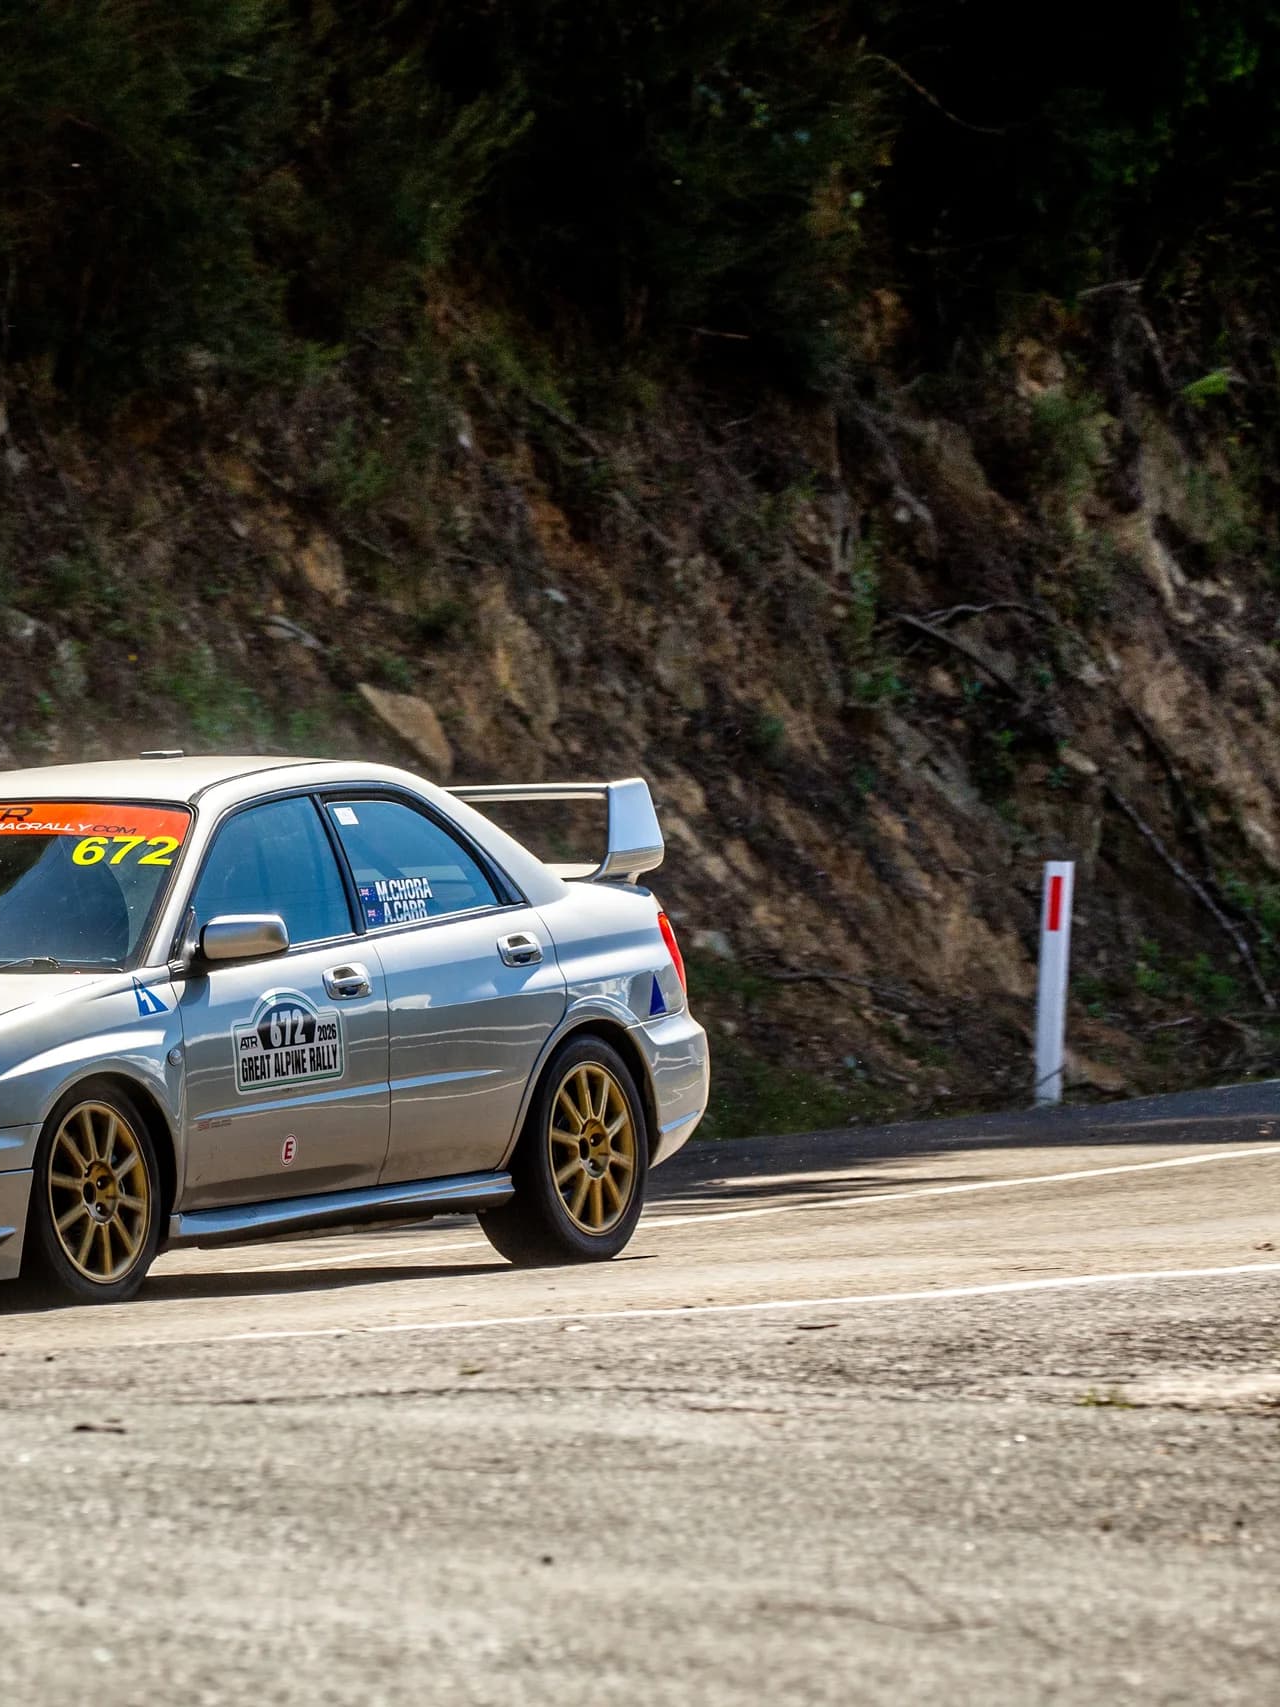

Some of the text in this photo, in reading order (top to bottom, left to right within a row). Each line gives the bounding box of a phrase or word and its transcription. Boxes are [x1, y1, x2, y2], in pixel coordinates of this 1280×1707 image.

[72, 836, 180, 866] 672
[375, 878, 433, 902] M.CHORA
[270, 1009, 306, 1047] 672
[317, 1023, 337, 1042] 2026
[240, 1036, 258, 1049] ATR
[241, 1044, 337, 1082] GREAT ALPINE RALLY
[284, 1141, 293, 1160] E
